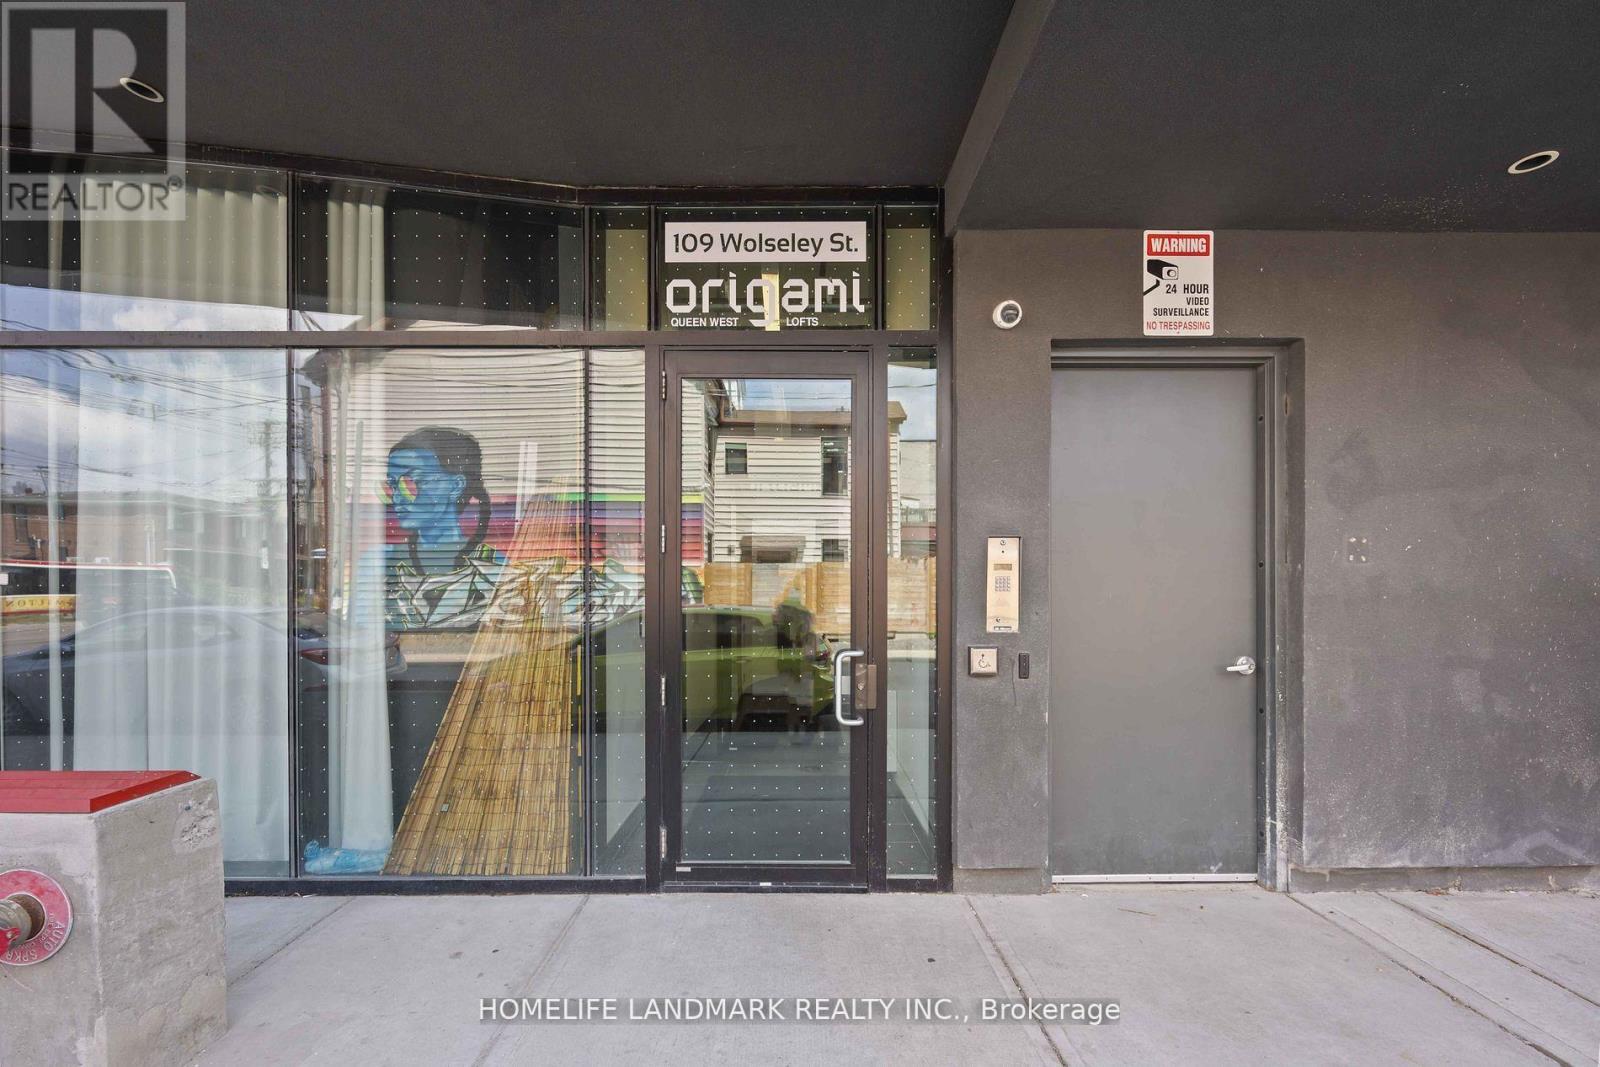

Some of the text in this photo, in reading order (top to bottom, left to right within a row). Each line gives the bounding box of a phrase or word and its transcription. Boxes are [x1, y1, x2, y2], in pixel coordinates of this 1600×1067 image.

[673, 232, 859, 257] 109 Wolseley St.
[1151, 238, 1207, 253] WARNING
[1165, 283, 1209, 294] 24 HOUR
[666, 271, 865, 327] origami
[1186, 297, 1210, 306] VIDEO
[1153, 307, 1209, 317] SURVEILLANCE
[670, 317, 819, 327] QUEEN WEST LOFTS
[1146, 321, 1211, 330] NO TRESPASSING
[43, 920, 66, 952] AUTO
